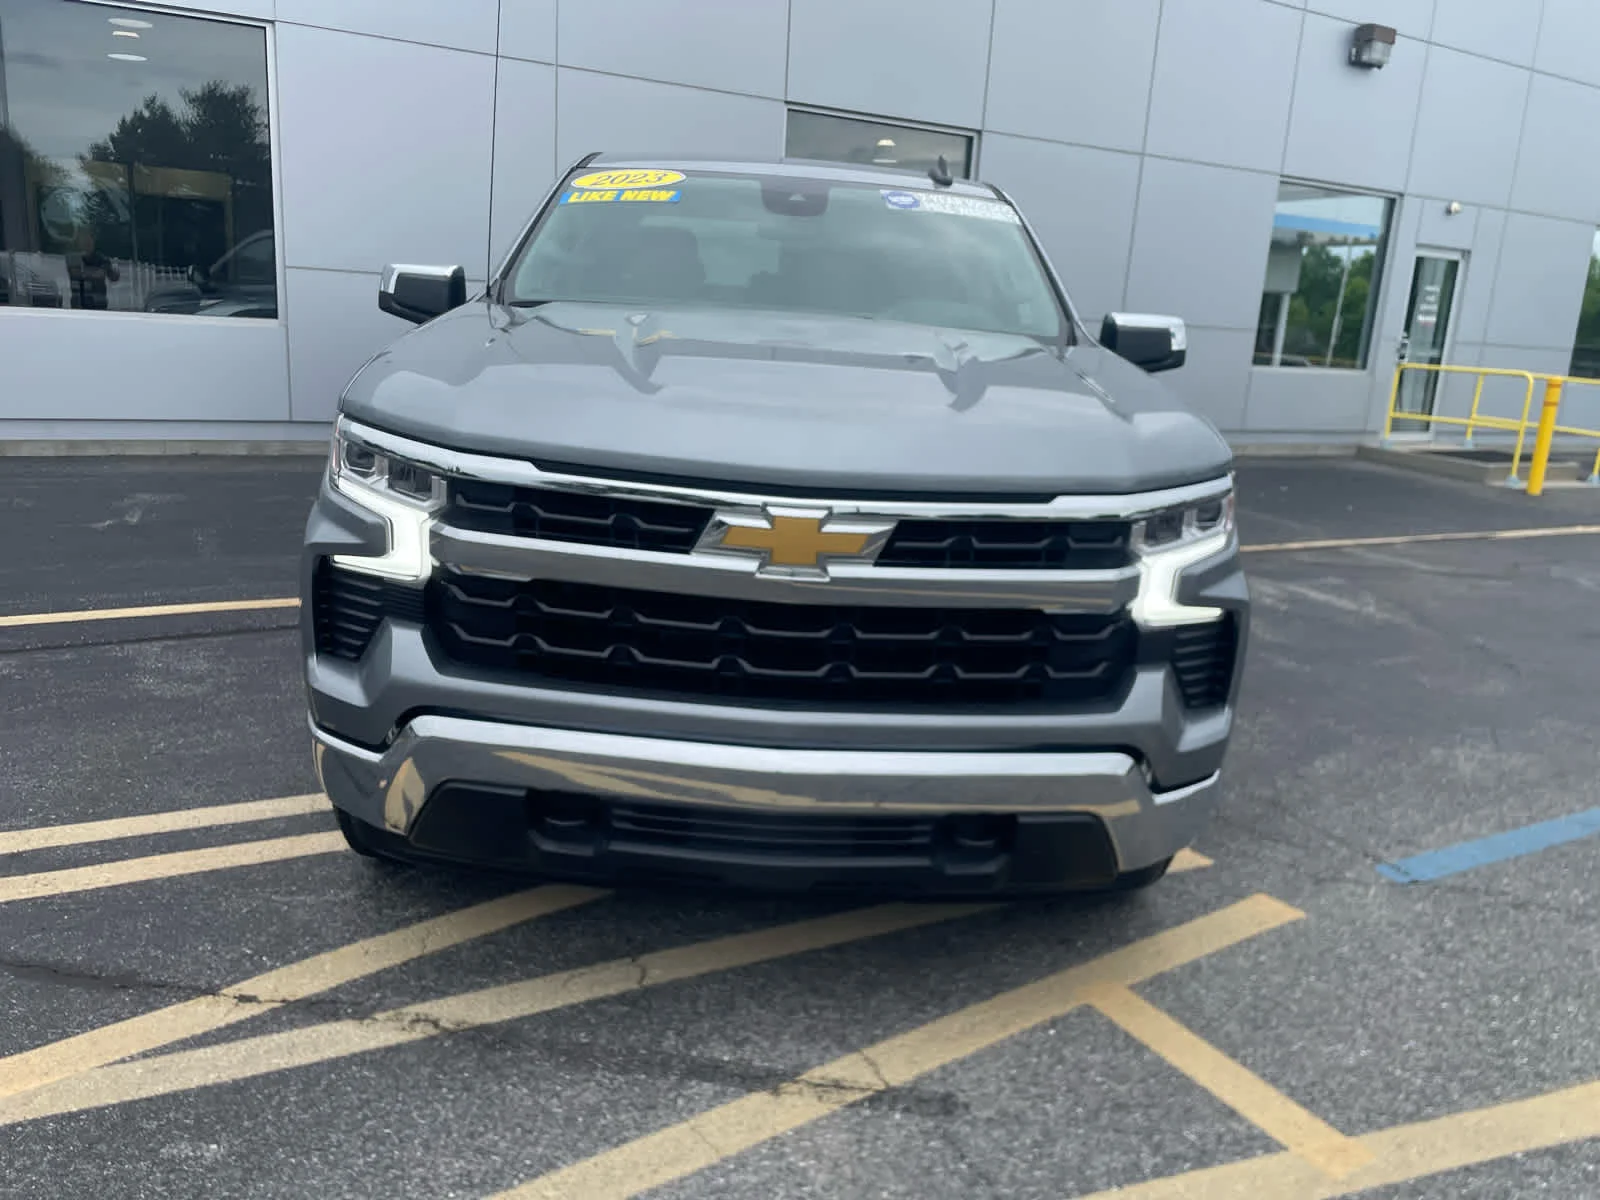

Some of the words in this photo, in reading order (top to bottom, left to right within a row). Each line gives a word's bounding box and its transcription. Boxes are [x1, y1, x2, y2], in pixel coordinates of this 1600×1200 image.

[589, 172, 668, 187] 2023
[568, 191, 618, 203] LIKE
[620, 190, 677, 202] NEW
